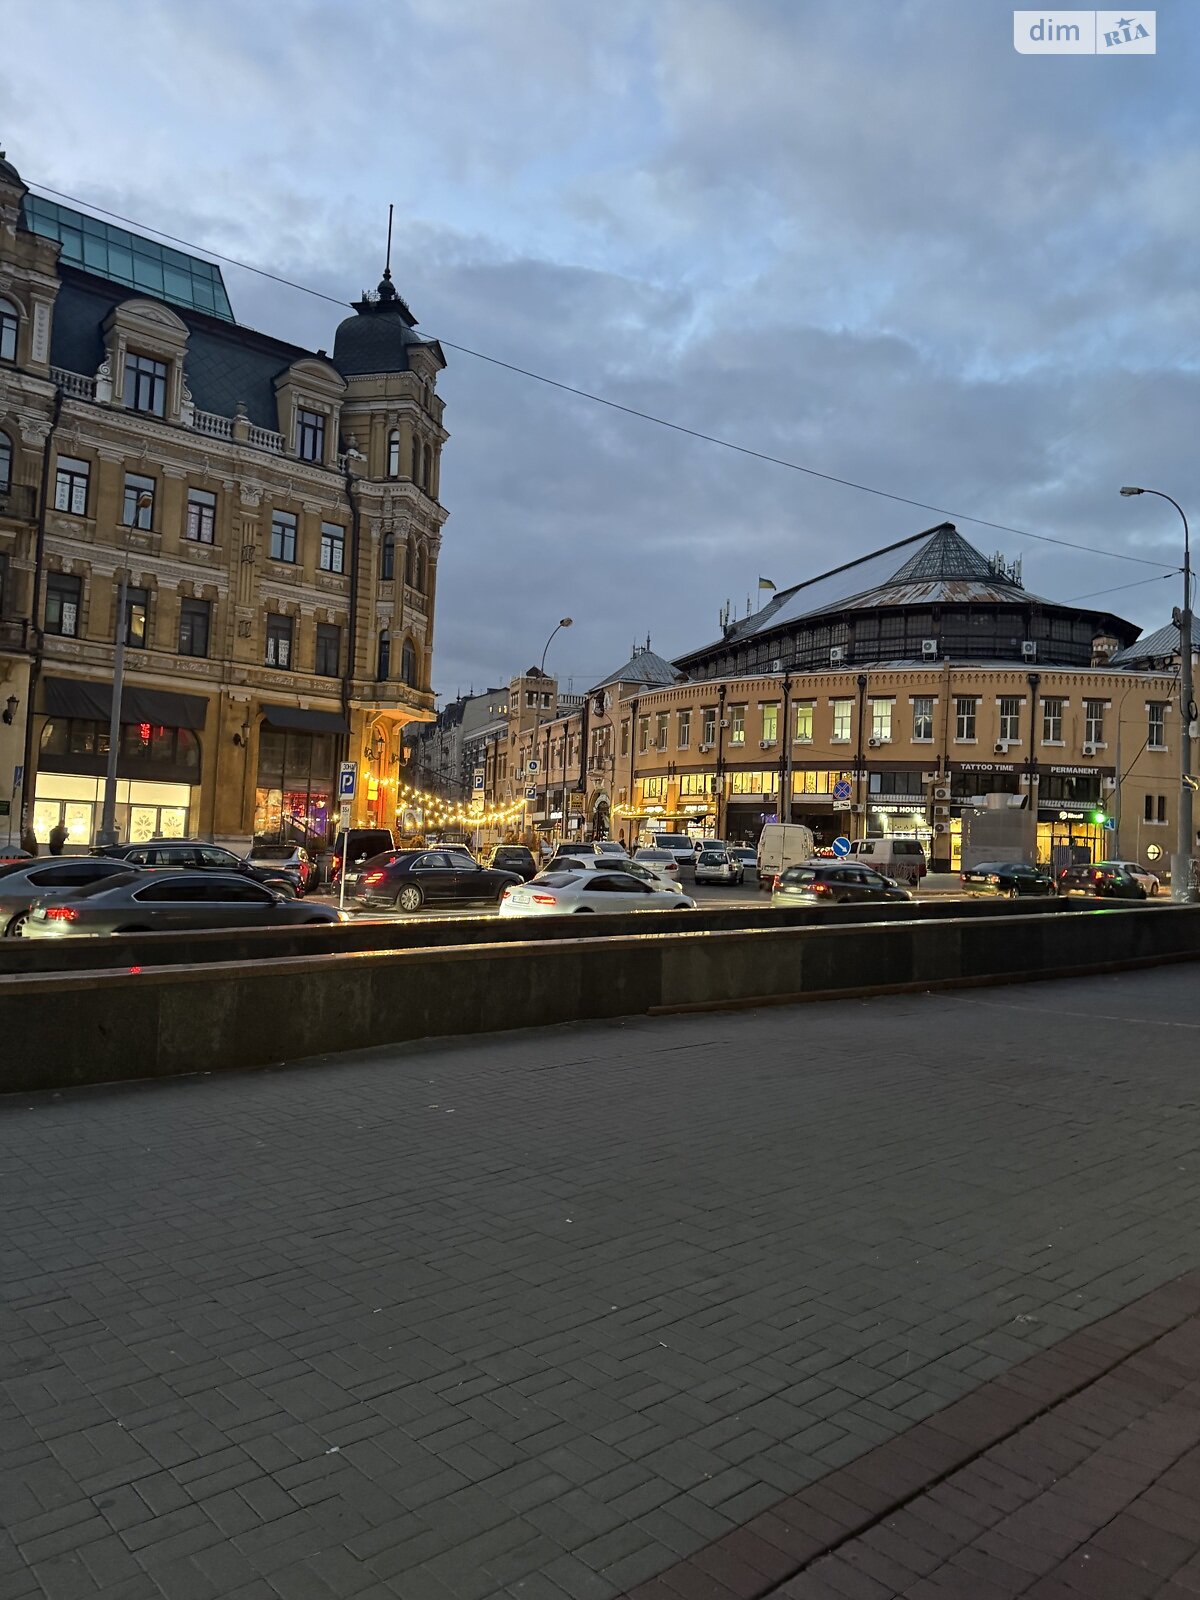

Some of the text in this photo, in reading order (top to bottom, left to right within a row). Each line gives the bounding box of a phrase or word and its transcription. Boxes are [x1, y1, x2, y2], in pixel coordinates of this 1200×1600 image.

[961, 763, 1014, 772] TATTOO TIME
[1050, 766, 1099, 775] PERMANENT
[871, 805, 926, 814] DONER HOUSE
